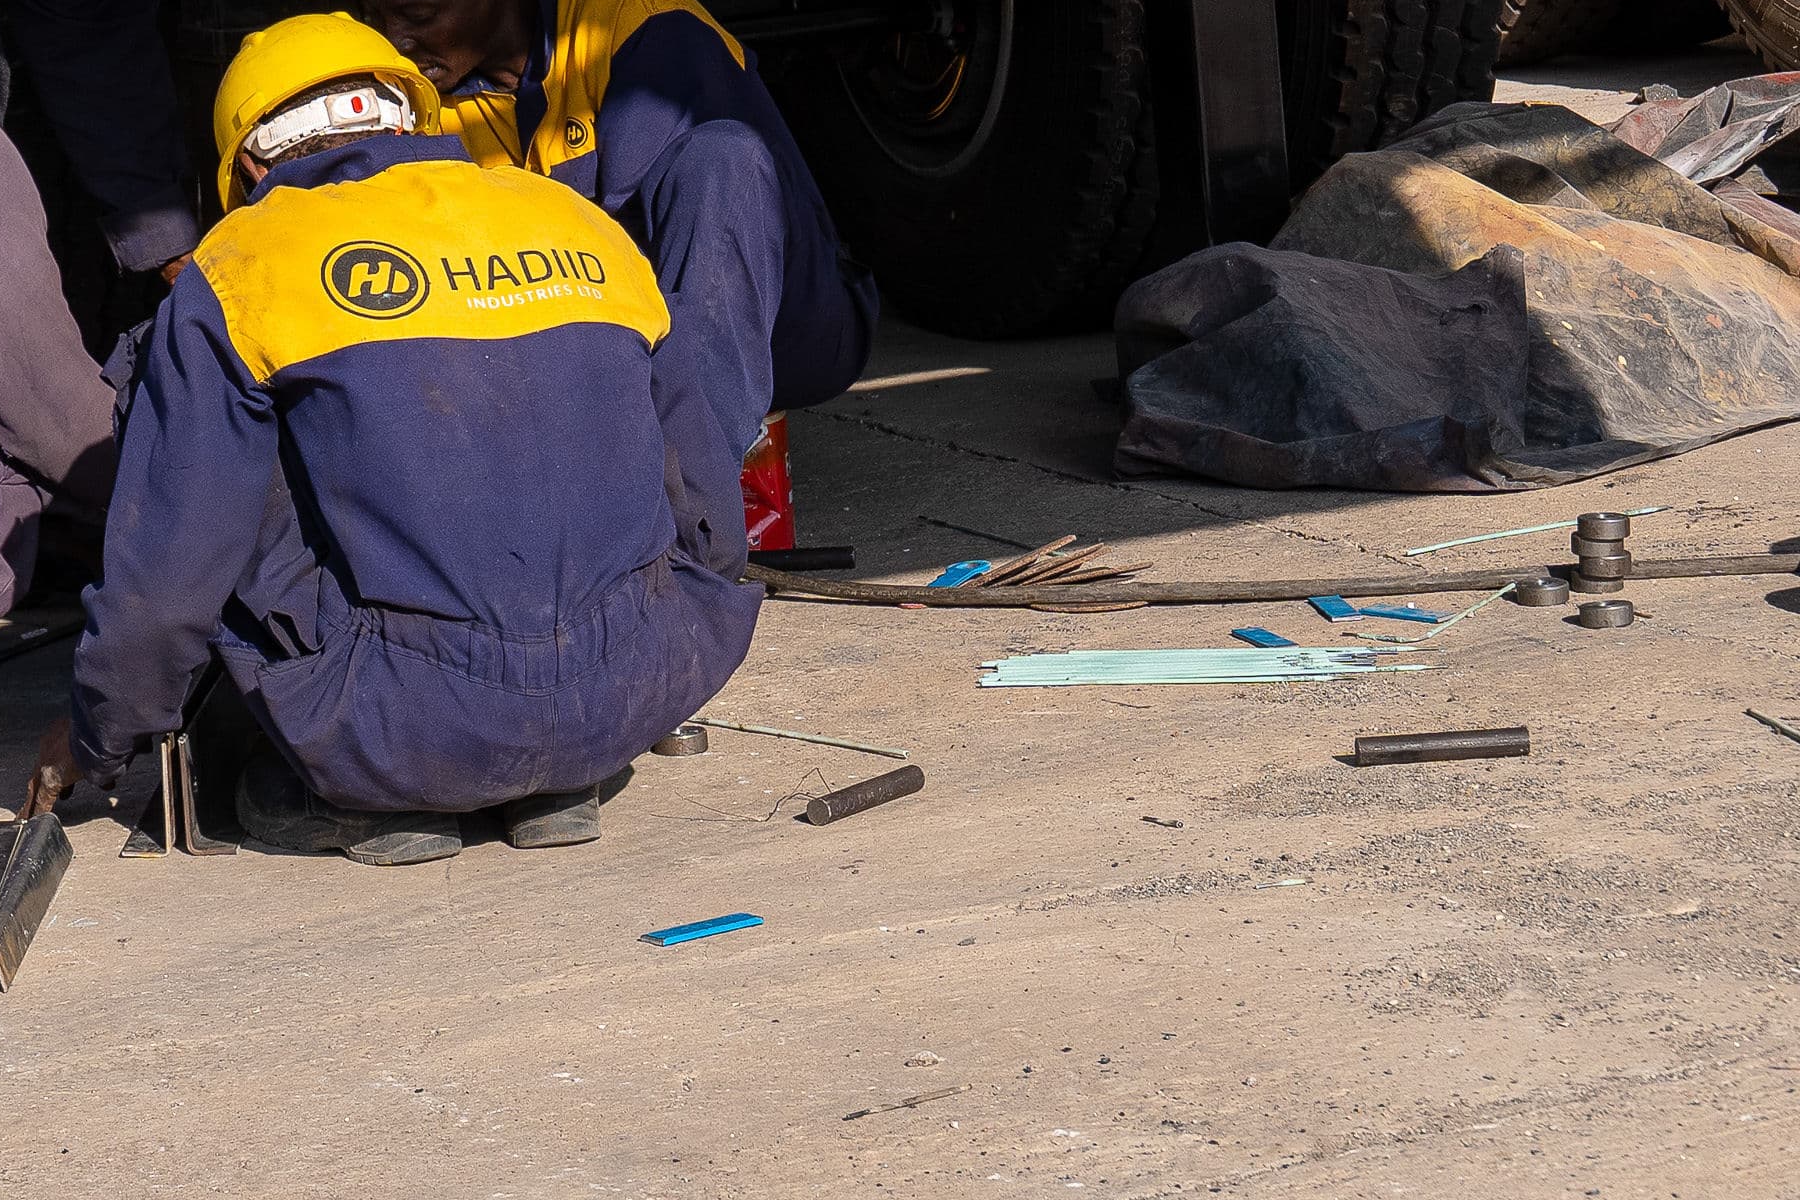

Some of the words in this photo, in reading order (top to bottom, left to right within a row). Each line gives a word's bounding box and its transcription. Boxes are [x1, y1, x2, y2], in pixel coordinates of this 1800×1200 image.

[346, 260, 411, 298] HD
[440, 248, 607, 291] HADIID
[466, 284, 573, 310] INDUSTRIES
[577, 285, 603, 300] LTD
